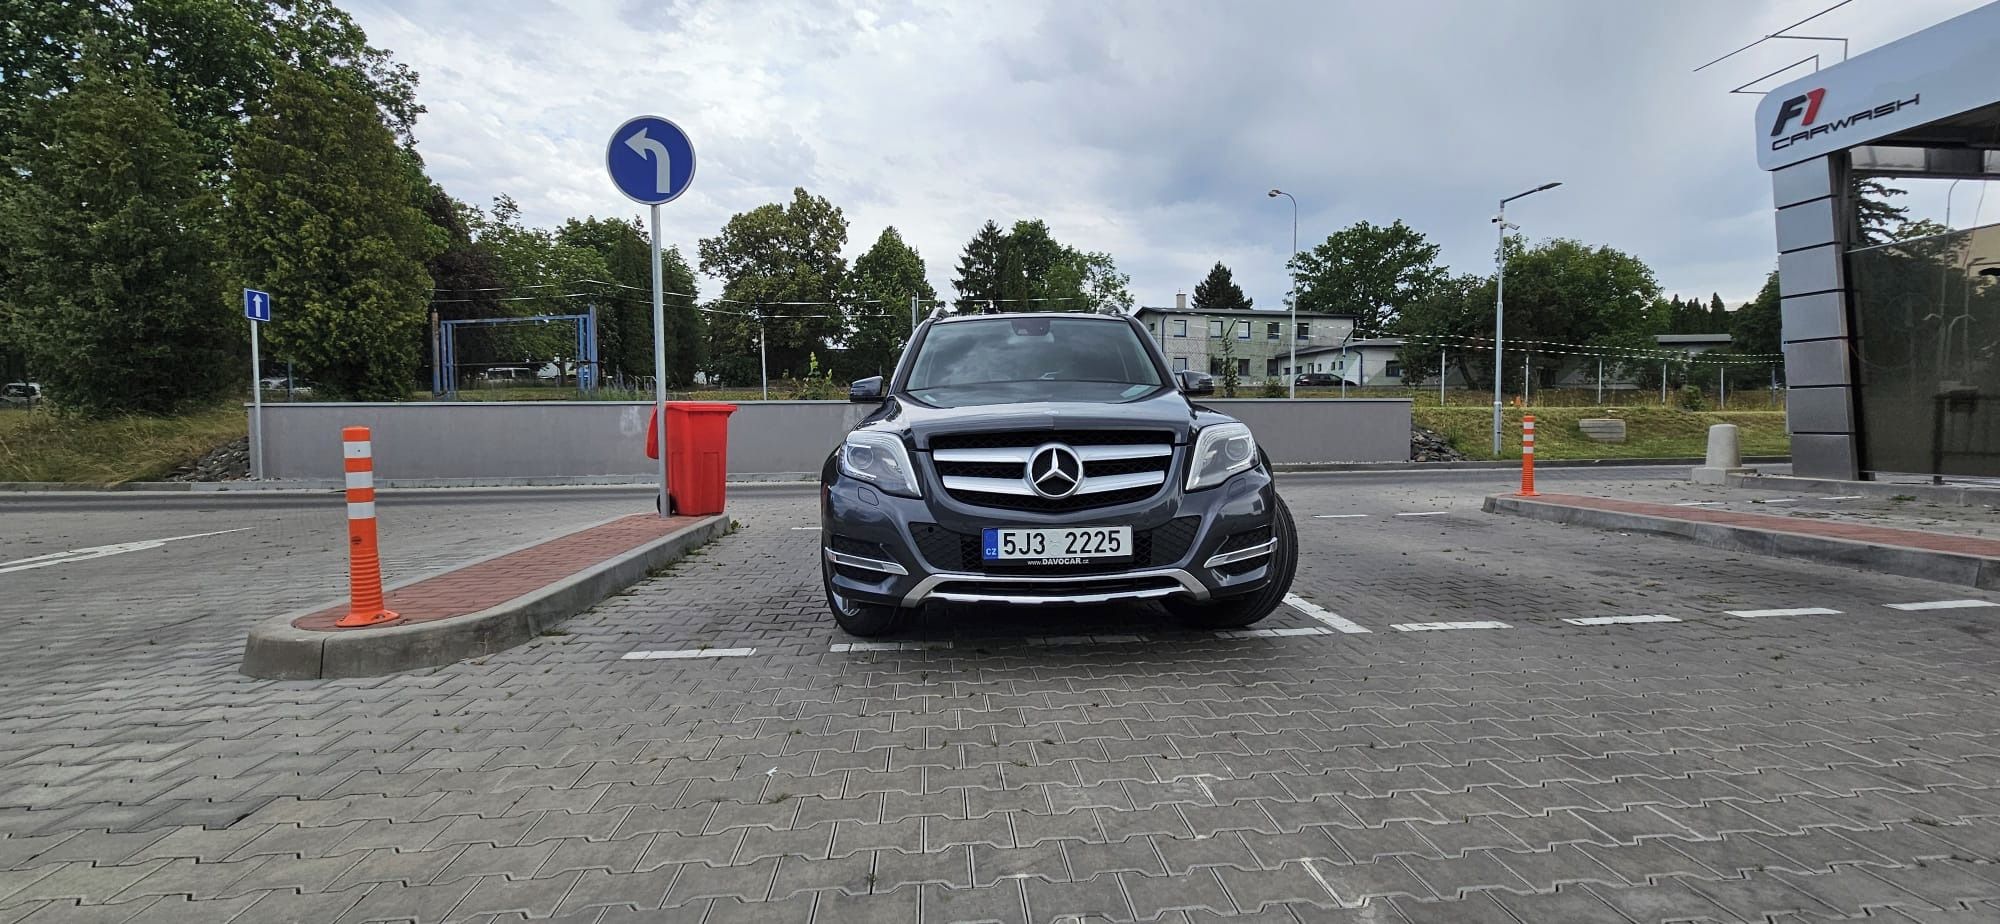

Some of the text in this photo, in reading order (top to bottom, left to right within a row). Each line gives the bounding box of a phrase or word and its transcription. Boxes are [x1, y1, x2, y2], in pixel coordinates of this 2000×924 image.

[1770, 87, 1826, 136] F1
[1771, 93, 1920, 151] CARWASH
[985, 548, 997, 556] CZ
[1003, 530, 1121, 556] 5J3 2225
[1027, 557, 1089, 566] www.DAVOCAR.cz
